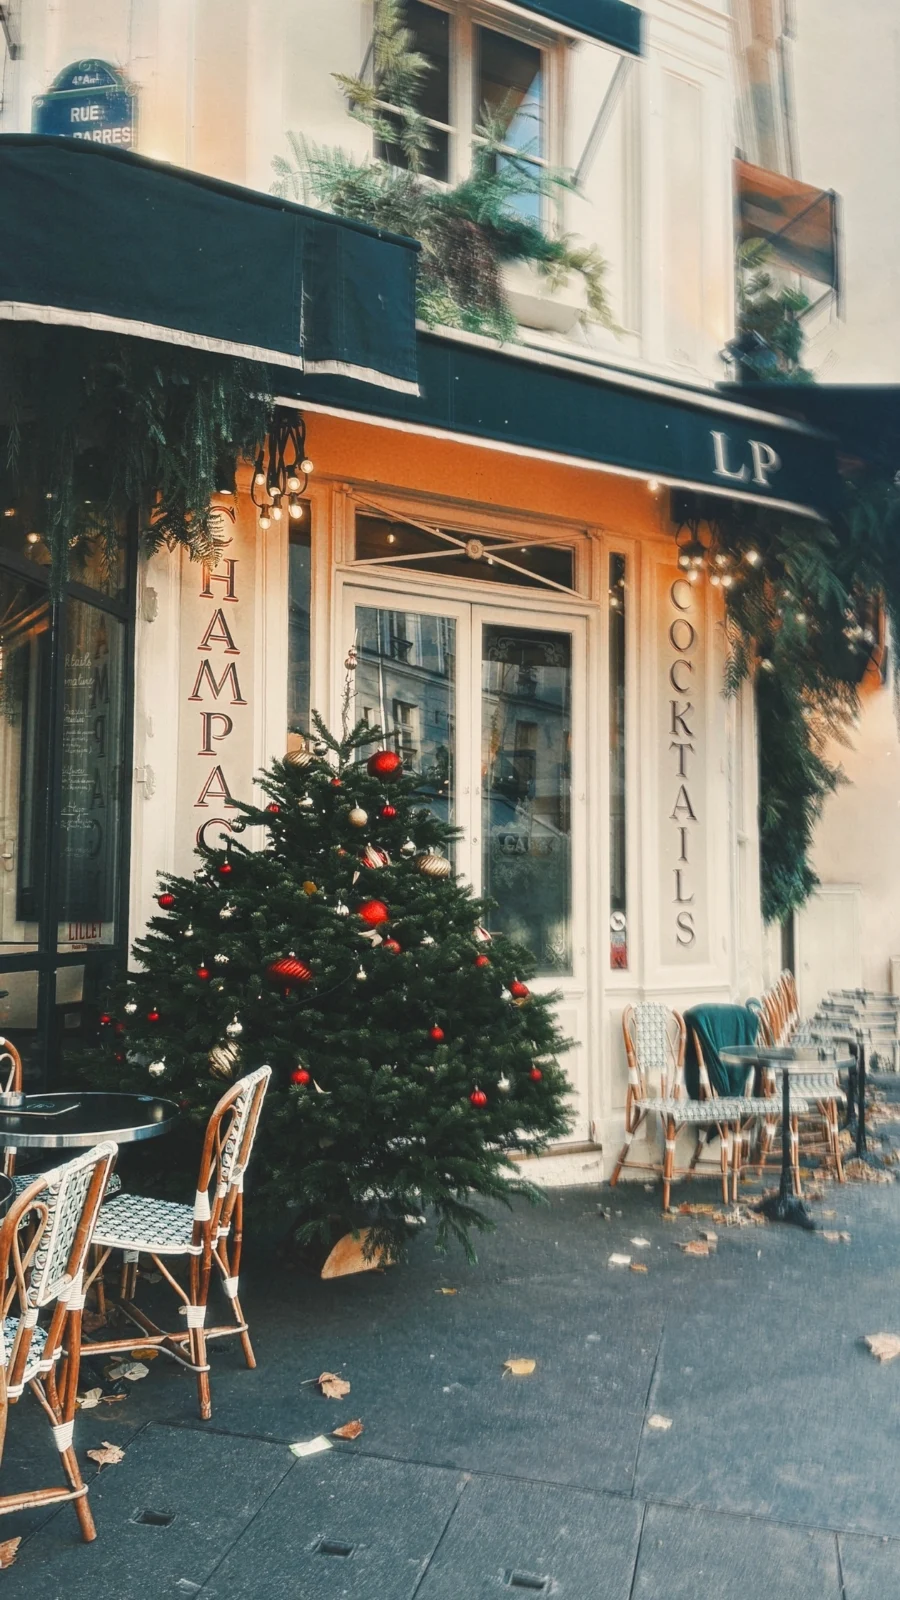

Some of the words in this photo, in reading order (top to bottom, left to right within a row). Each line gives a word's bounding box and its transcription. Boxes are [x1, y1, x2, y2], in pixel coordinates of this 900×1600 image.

[70, 105, 99, 122] RUE
[709, 429, 779, 486] LP
[669, 578, 698, 947] COCKTAILS
[68, 919, 103, 941] LILLET
